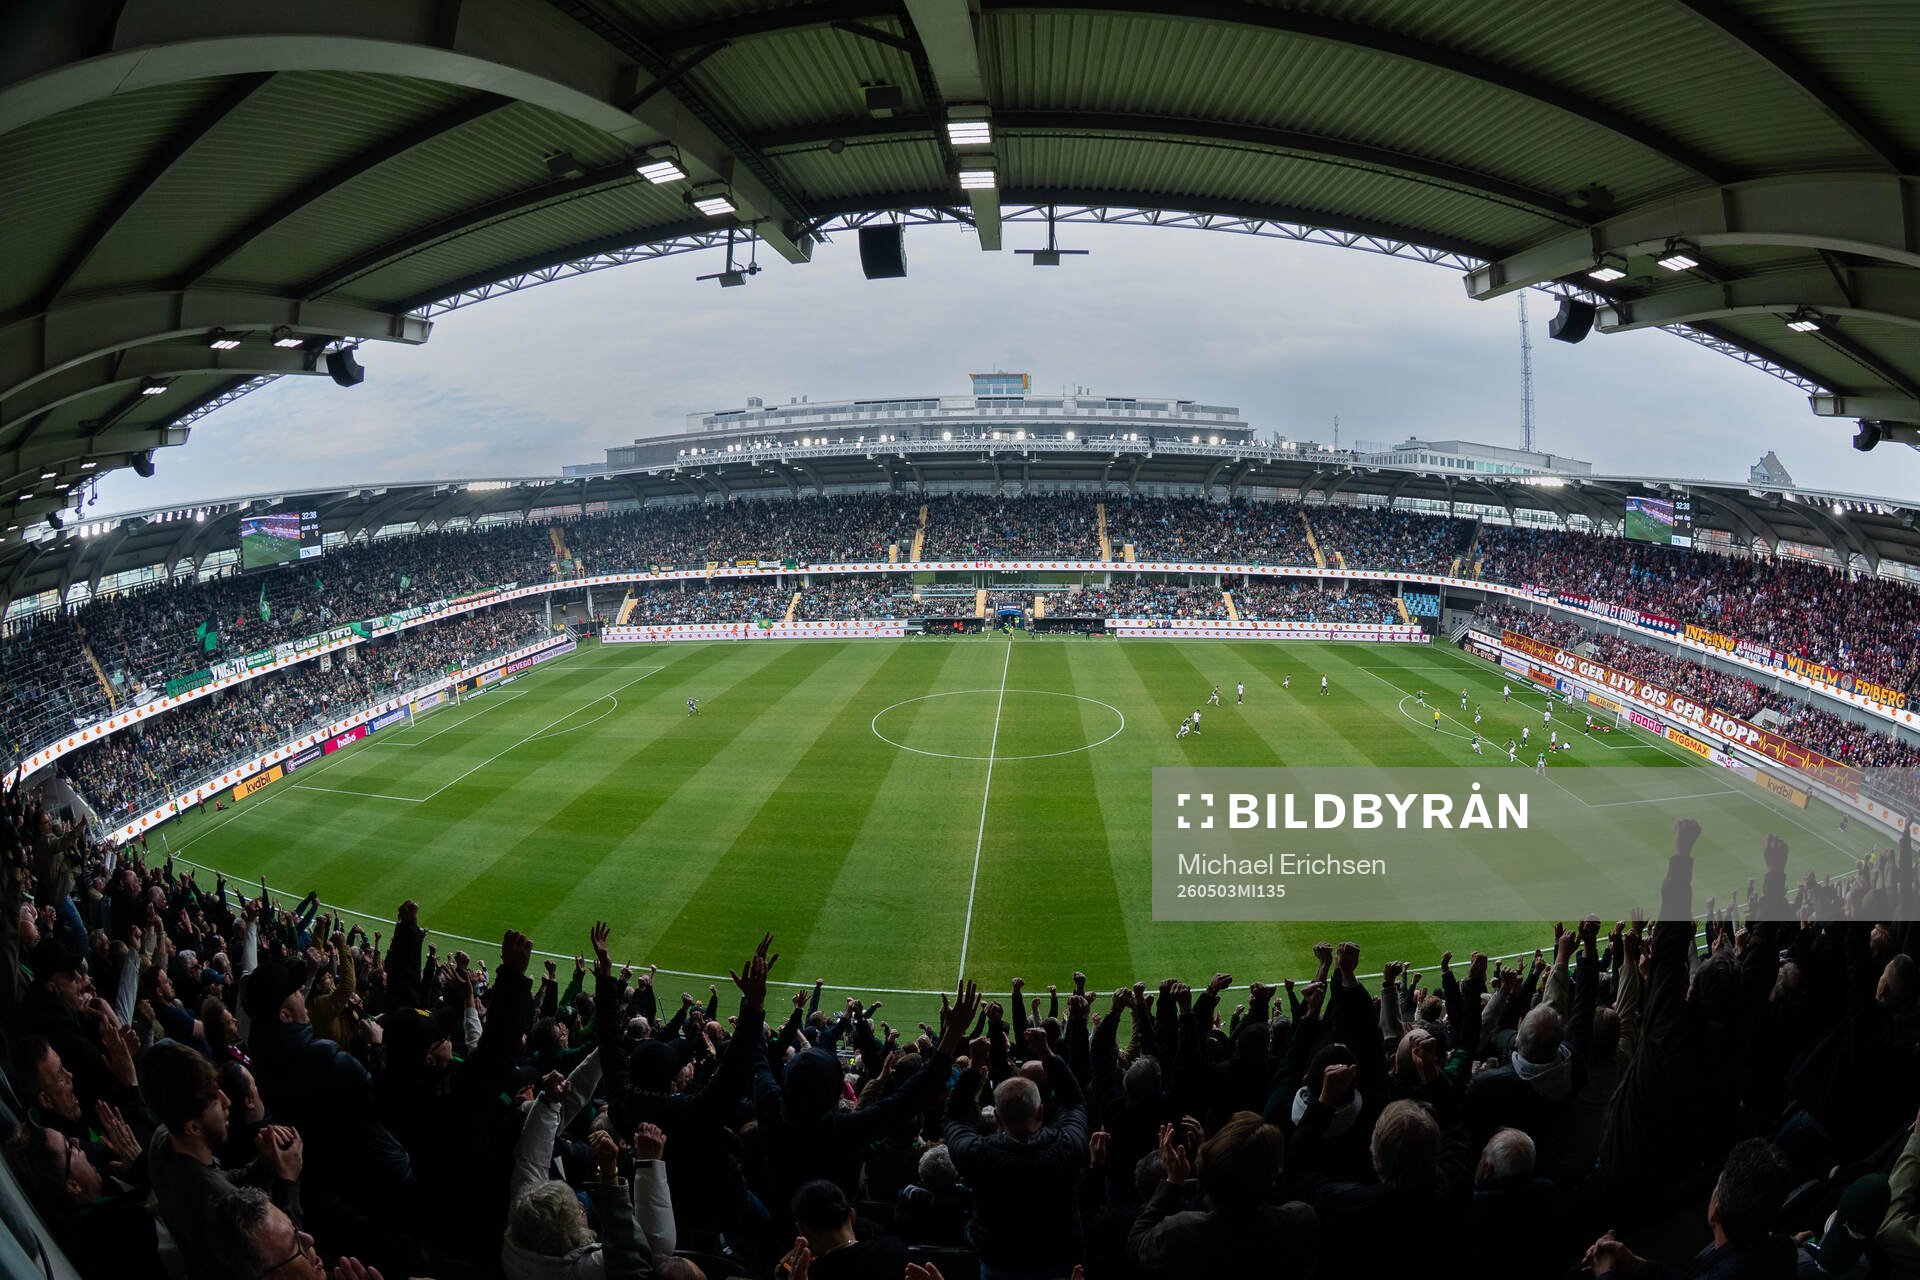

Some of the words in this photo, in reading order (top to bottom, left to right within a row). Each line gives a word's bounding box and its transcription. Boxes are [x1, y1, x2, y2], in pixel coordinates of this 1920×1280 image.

[1588, 600, 1609, 615] AMOR
[1610, 604, 1619, 617] ET
[1619, 607, 1640, 625] FIDES
[295, 637, 319, 652] GAIS
[330, 626, 352, 640] TIFO
[1685, 623, 1735, 651] INFERNO
[1743, 641, 1771, 657] BALDERS
[507, 659, 532, 673] BEVEGO
[467, 688, 487, 699] UNIBET
[1787, 654, 1838, 687] WILHELM
[1854, 679, 1906, 709] FRIBERG
[1555, 651, 1575, 670] ÖIS
[1579, 662, 1605, 680] GER
[1641, 683, 1667, 705] ÖIS
[1673, 698, 1704, 723] GER
[1709, 713, 1759, 746] HOPP
[1669, 730, 1709, 756] BYGGMAX
[245, 772, 272, 794] kvdbil
[1767, 778, 1793, 801] kvdbil
